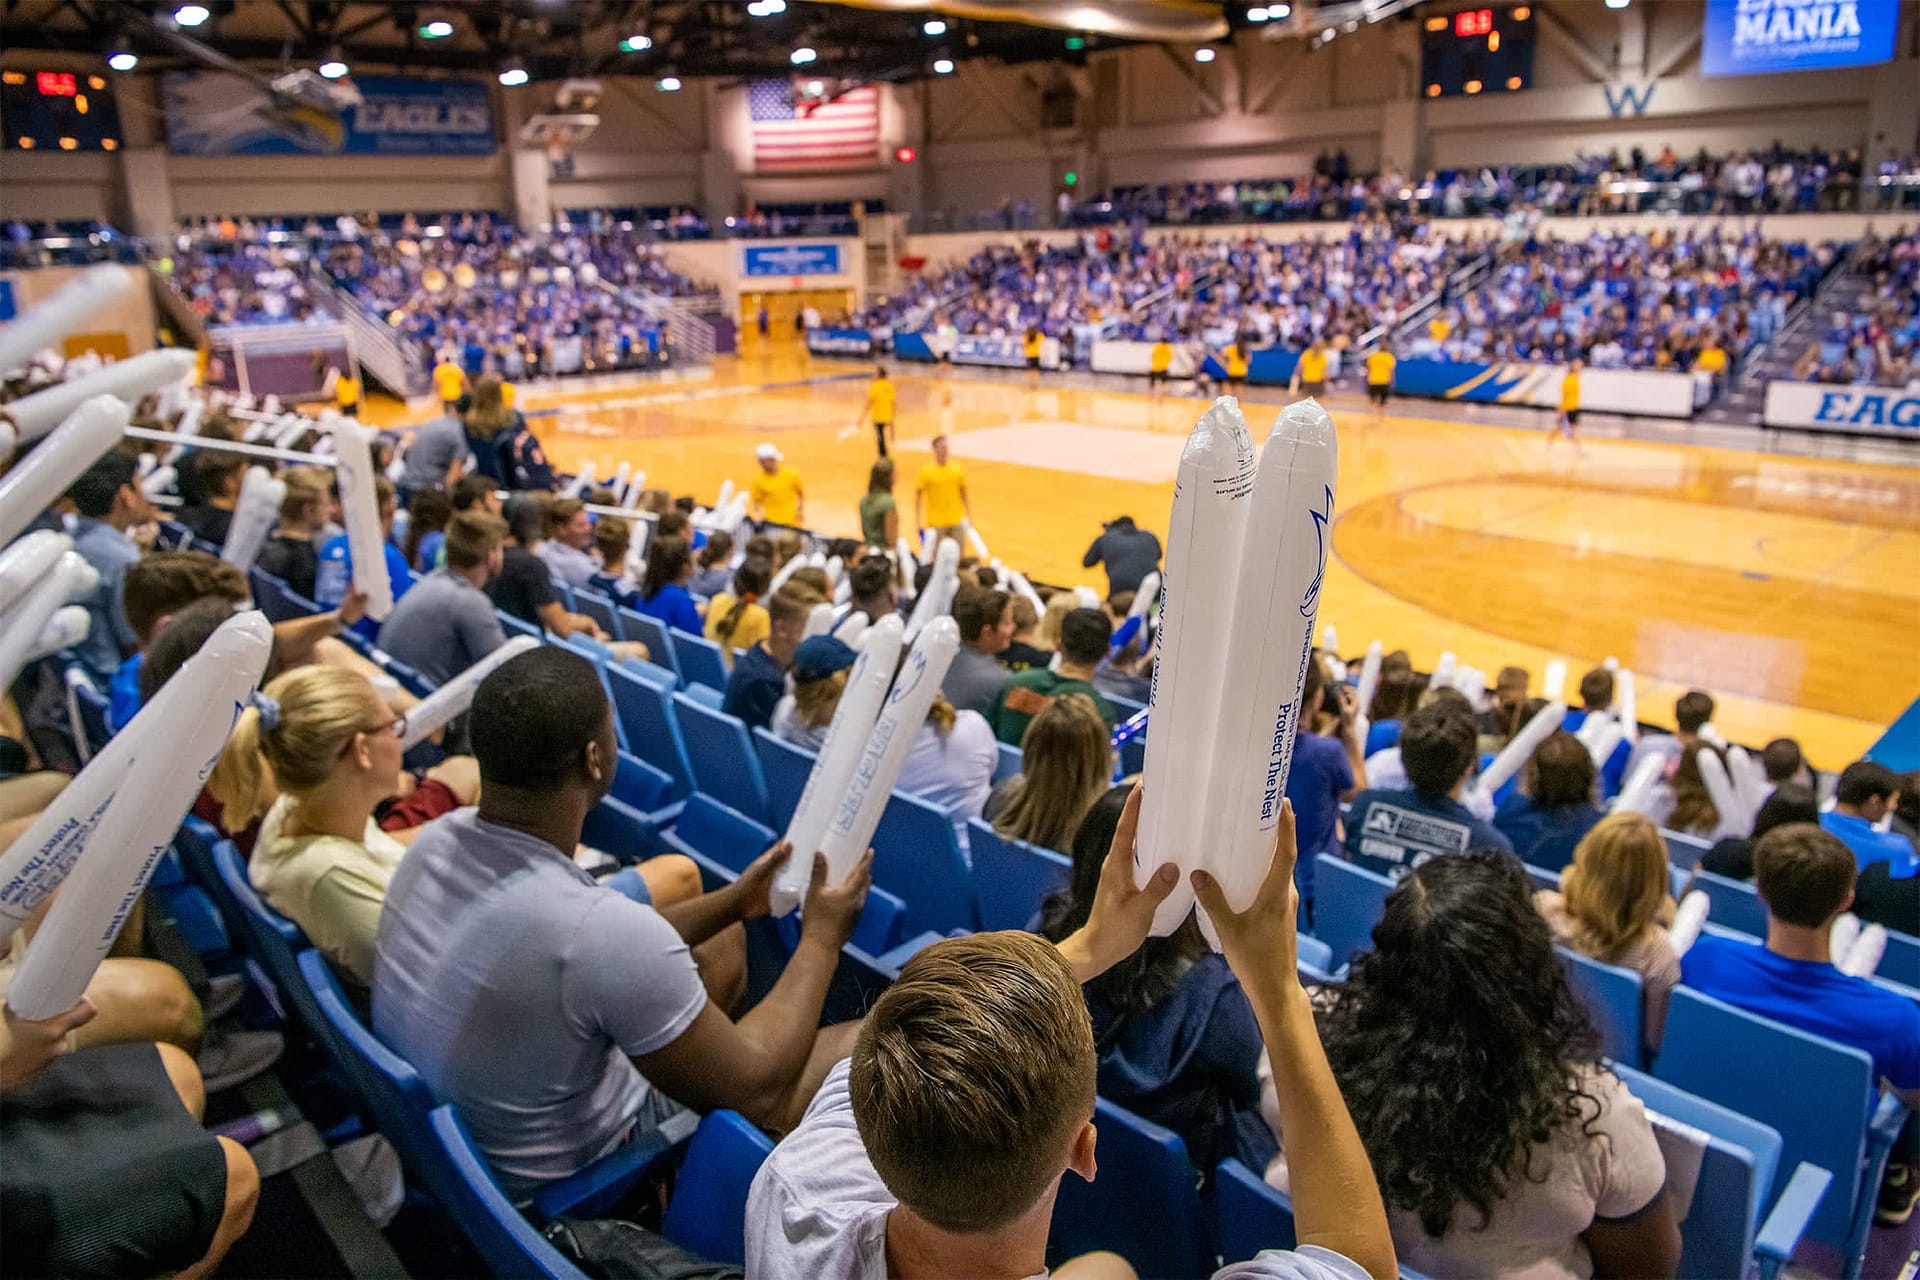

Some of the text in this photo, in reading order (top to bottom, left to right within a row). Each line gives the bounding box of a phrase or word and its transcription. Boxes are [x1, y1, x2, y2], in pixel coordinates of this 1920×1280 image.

[1734, 3, 1861, 46] MANIA
[356, 103, 489, 132] EAGLES
[1603, 84, 1655, 115] W
[1296, 620, 1312, 694] PENSACOLA
[837, 718, 897, 831] EAGLES
[1260, 703, 1291, 820] Protect The Nest
[41, 817, 80, 856] Protect
[21, 855, 44, 877] The
[132, 845, 164, 887] Protect
[118, 891, 137, 914] The
